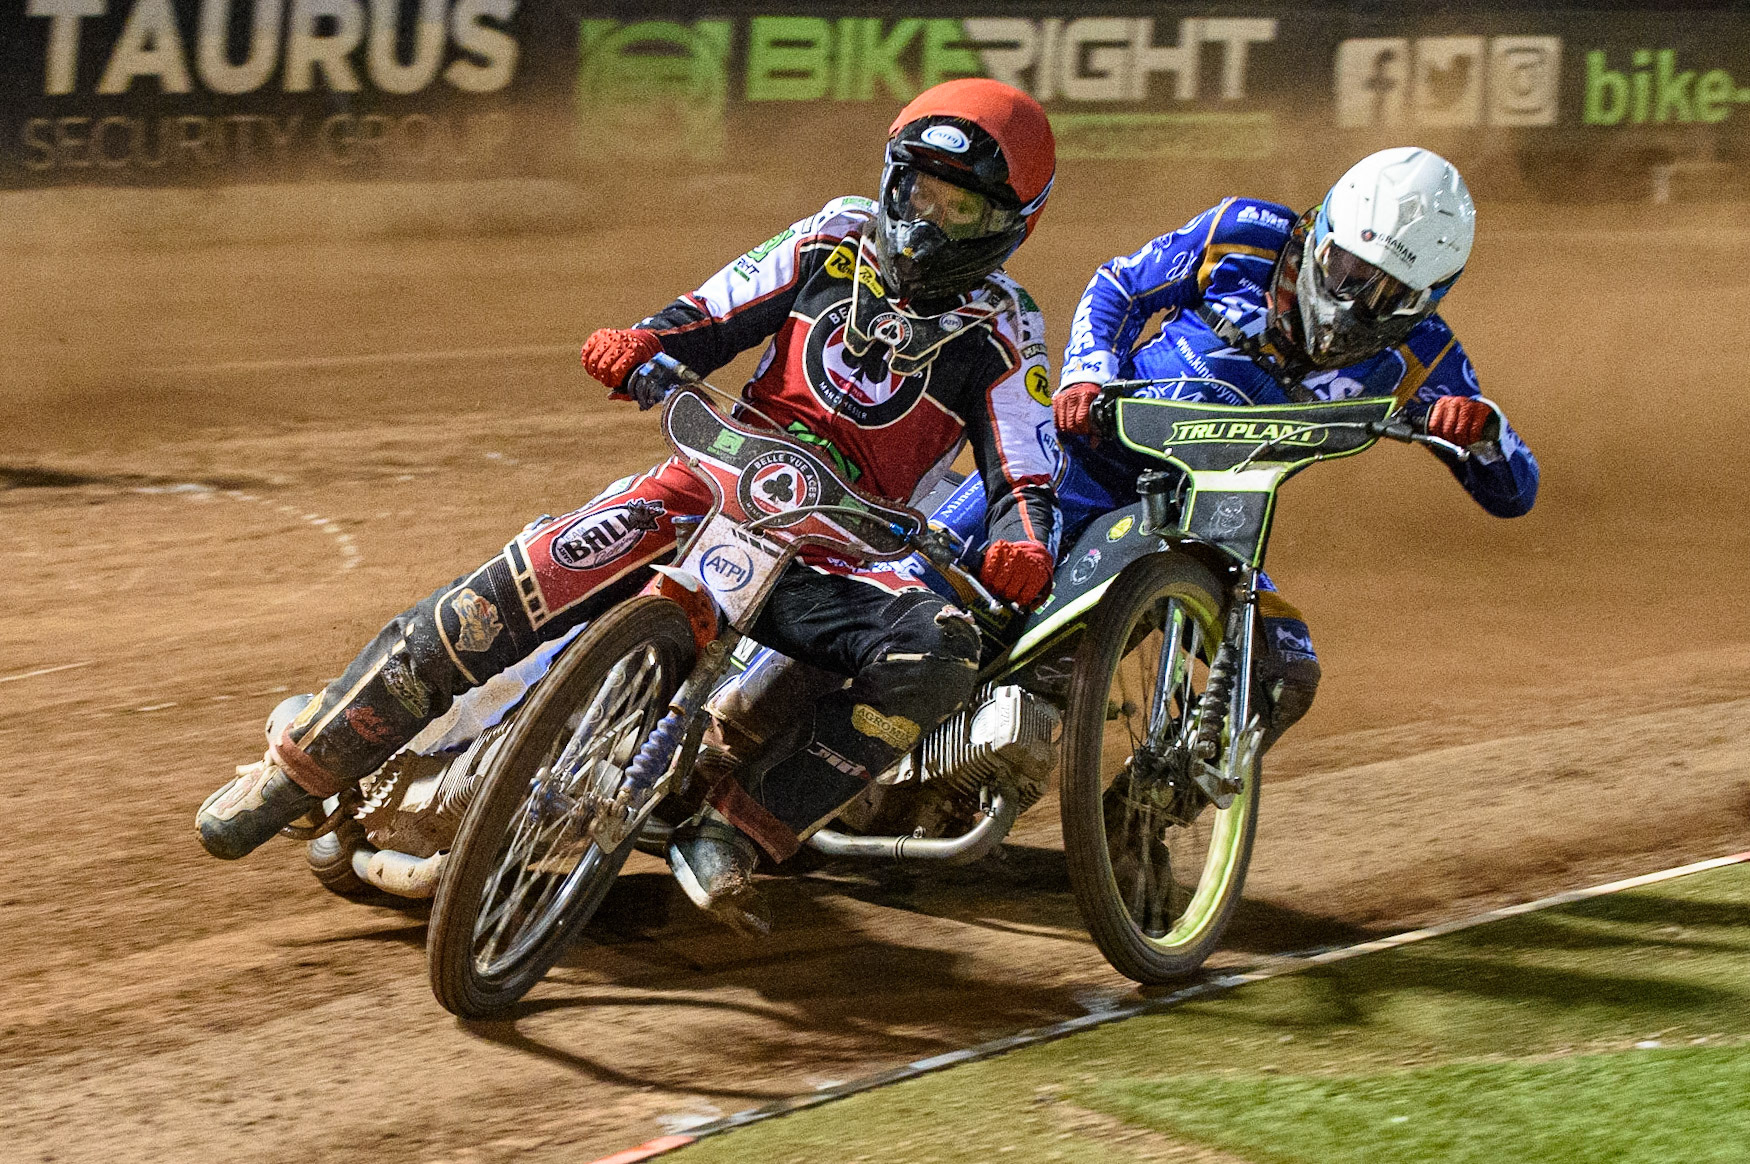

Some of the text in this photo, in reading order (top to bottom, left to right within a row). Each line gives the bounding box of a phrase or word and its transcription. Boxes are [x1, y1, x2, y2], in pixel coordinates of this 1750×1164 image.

[26, 0, 519, 95] TAURUS
[1178, 423, 1226, 440] TRU
[754, 454, 785, 469] BELLE
[789, 456, 808, 472] VUE
[806, 474, 817, 498] ACES
[706, 556, 746, 582] ATPI
